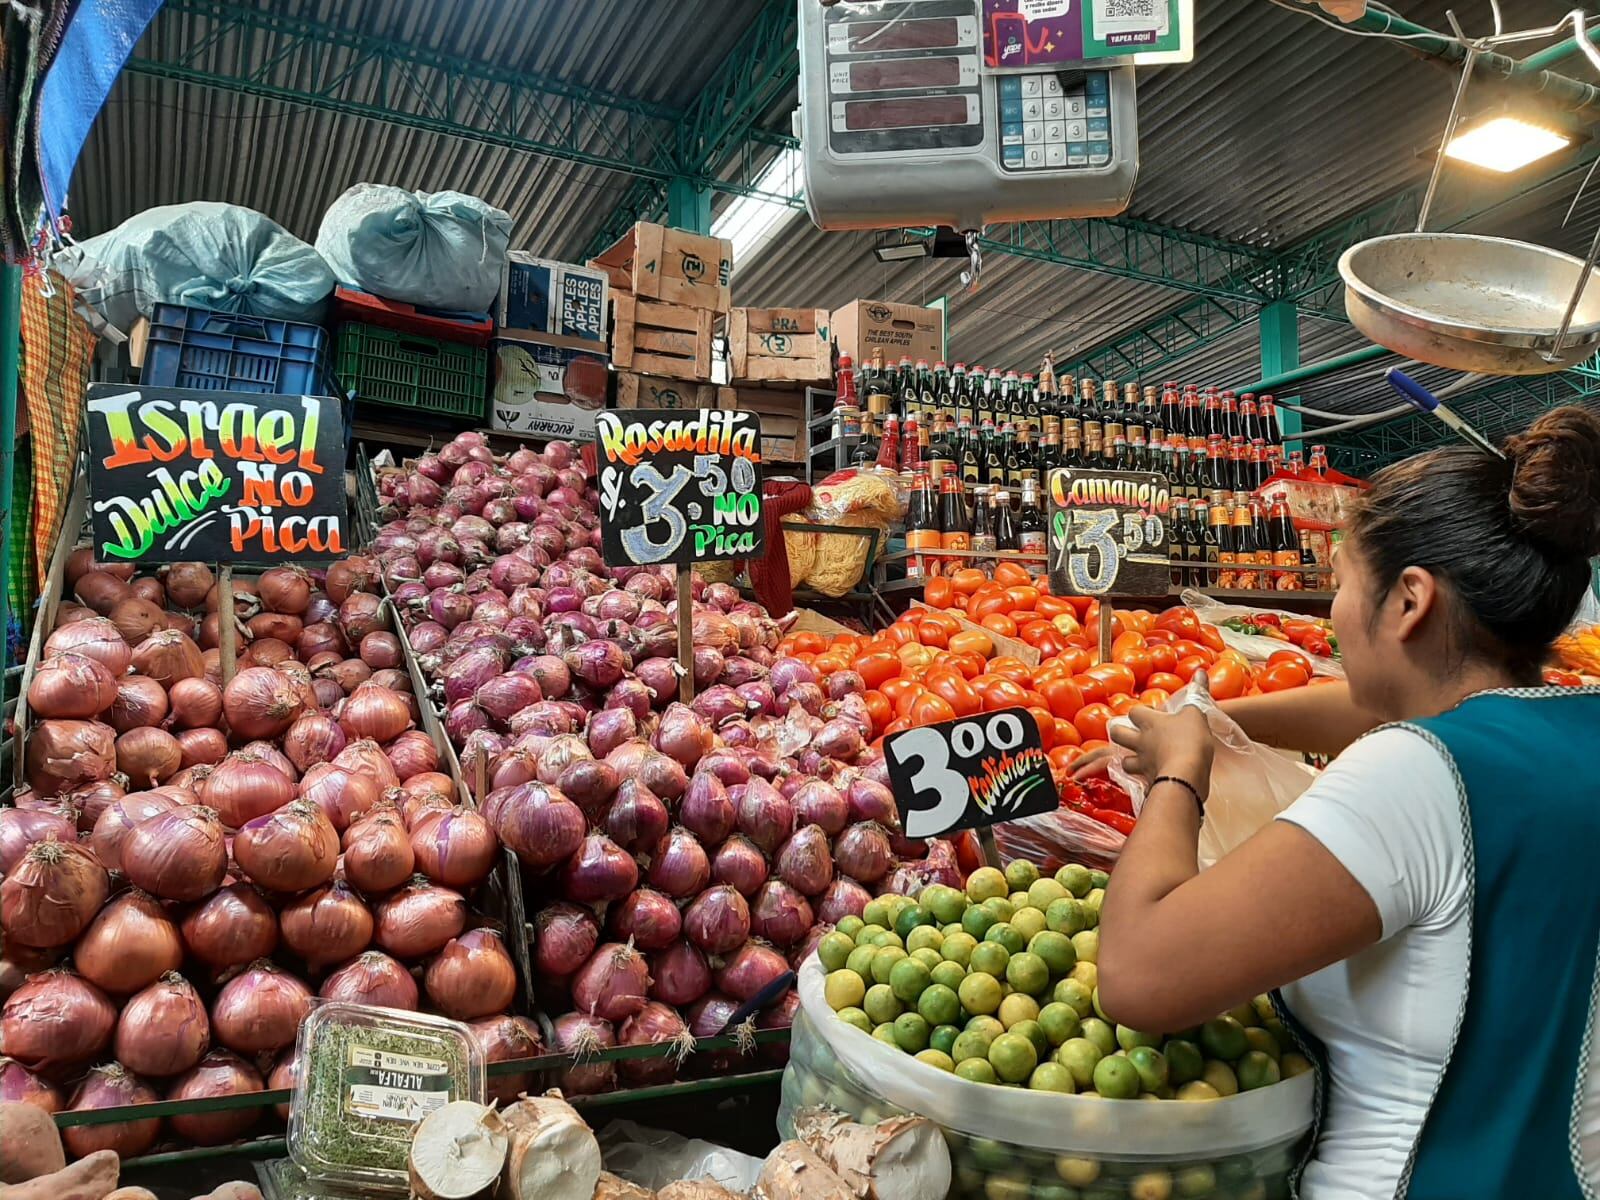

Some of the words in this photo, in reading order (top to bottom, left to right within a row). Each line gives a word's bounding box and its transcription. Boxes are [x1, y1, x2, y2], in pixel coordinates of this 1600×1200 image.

[1110, 34, 1132, 44] YAPEA
[1133, 31, 1151, 43] AQUÍ
[1001, 43, 1022, 60] yape
[831, 77, 849, 85] PRICE
[1027, 81, 1036, 92] 7
[1048, 80, 1057, 91] 8
[1028, 104, 1036, 116] 4
[1049, 103, 1058, 114] 5
[1071, 102, 1079, 113] 6
[1031, 127, 1036, 138] 1
[1051, 126, 1059, 137] 2
[1072, 125, 1080, 136] 3
[1031, 150, 1038, 161] 0
[563, 277, 577, 330] APPLES
[575, 280, 590, 332] APPLES
[587, 283, 602, 334] APPLES
[864, 336, 889, 345] CHILEAN
[889, 338, 911, 346] APPLES
[867, 329, 879, 337] THE
[879, 330, 894, 338] BEST
[894, 331, 914, 340] SOUTH
[87, 391, 324, 474] Israel
[527, 418, 575, 435] RUCARAY
[596, 408, 762, 466] Rosadita
[236, 461, 315, 508] No
[94, 458, 231, 559] Dulce
[713, 492, 760, 526] NO
[221, 505, 347, 554] Pica
[688, 524, 761, 557] Pica
[378, 1070, 424, 1090] ALFALFA
